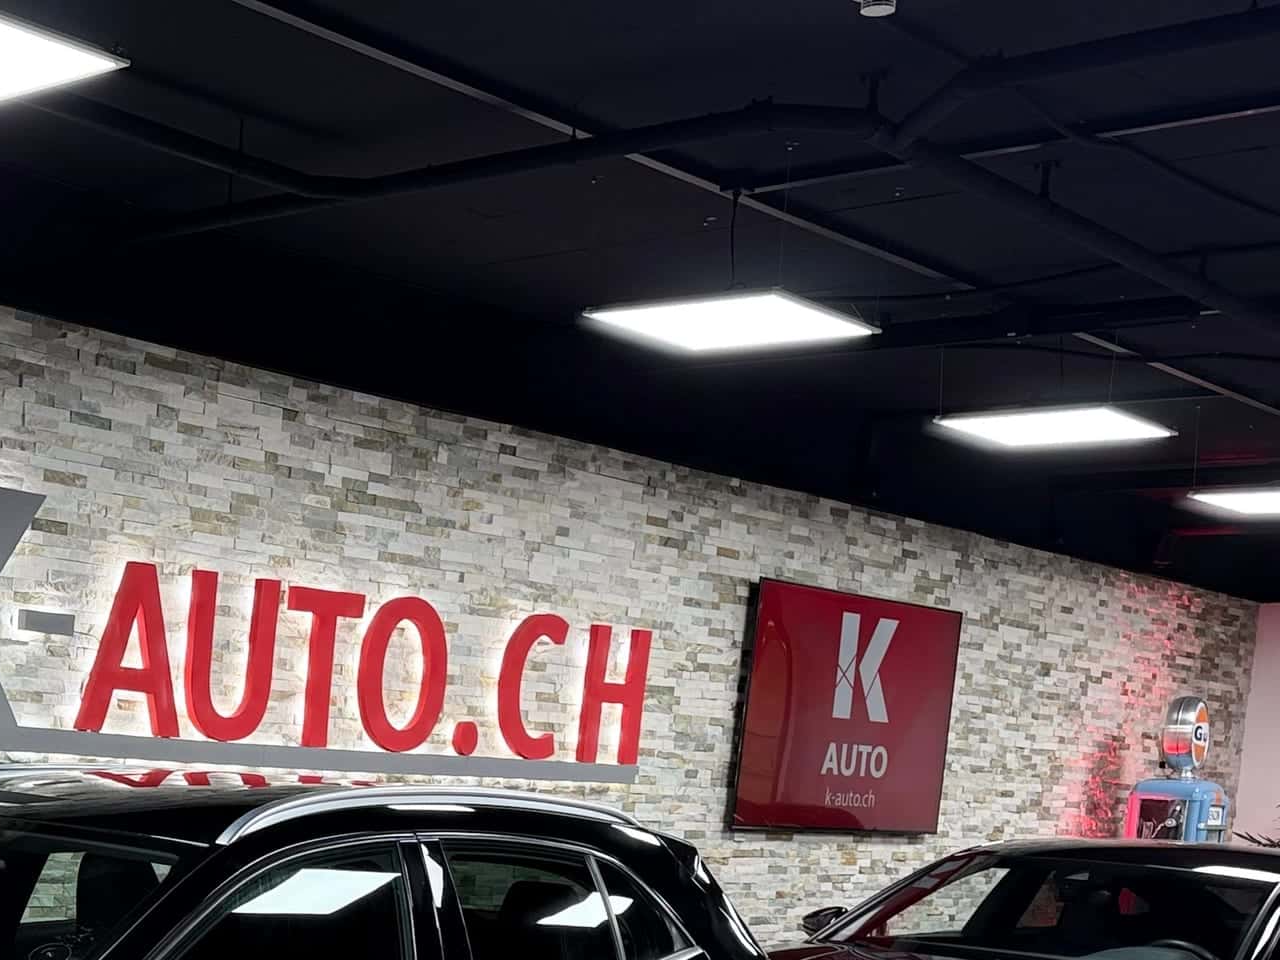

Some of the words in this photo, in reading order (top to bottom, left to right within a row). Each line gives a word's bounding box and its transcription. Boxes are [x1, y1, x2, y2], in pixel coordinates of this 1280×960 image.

[832, 611, 900, 723] K
[821, 742, 888, 778] AUTO
[825, 788, 875, 808] k-auto.ch
